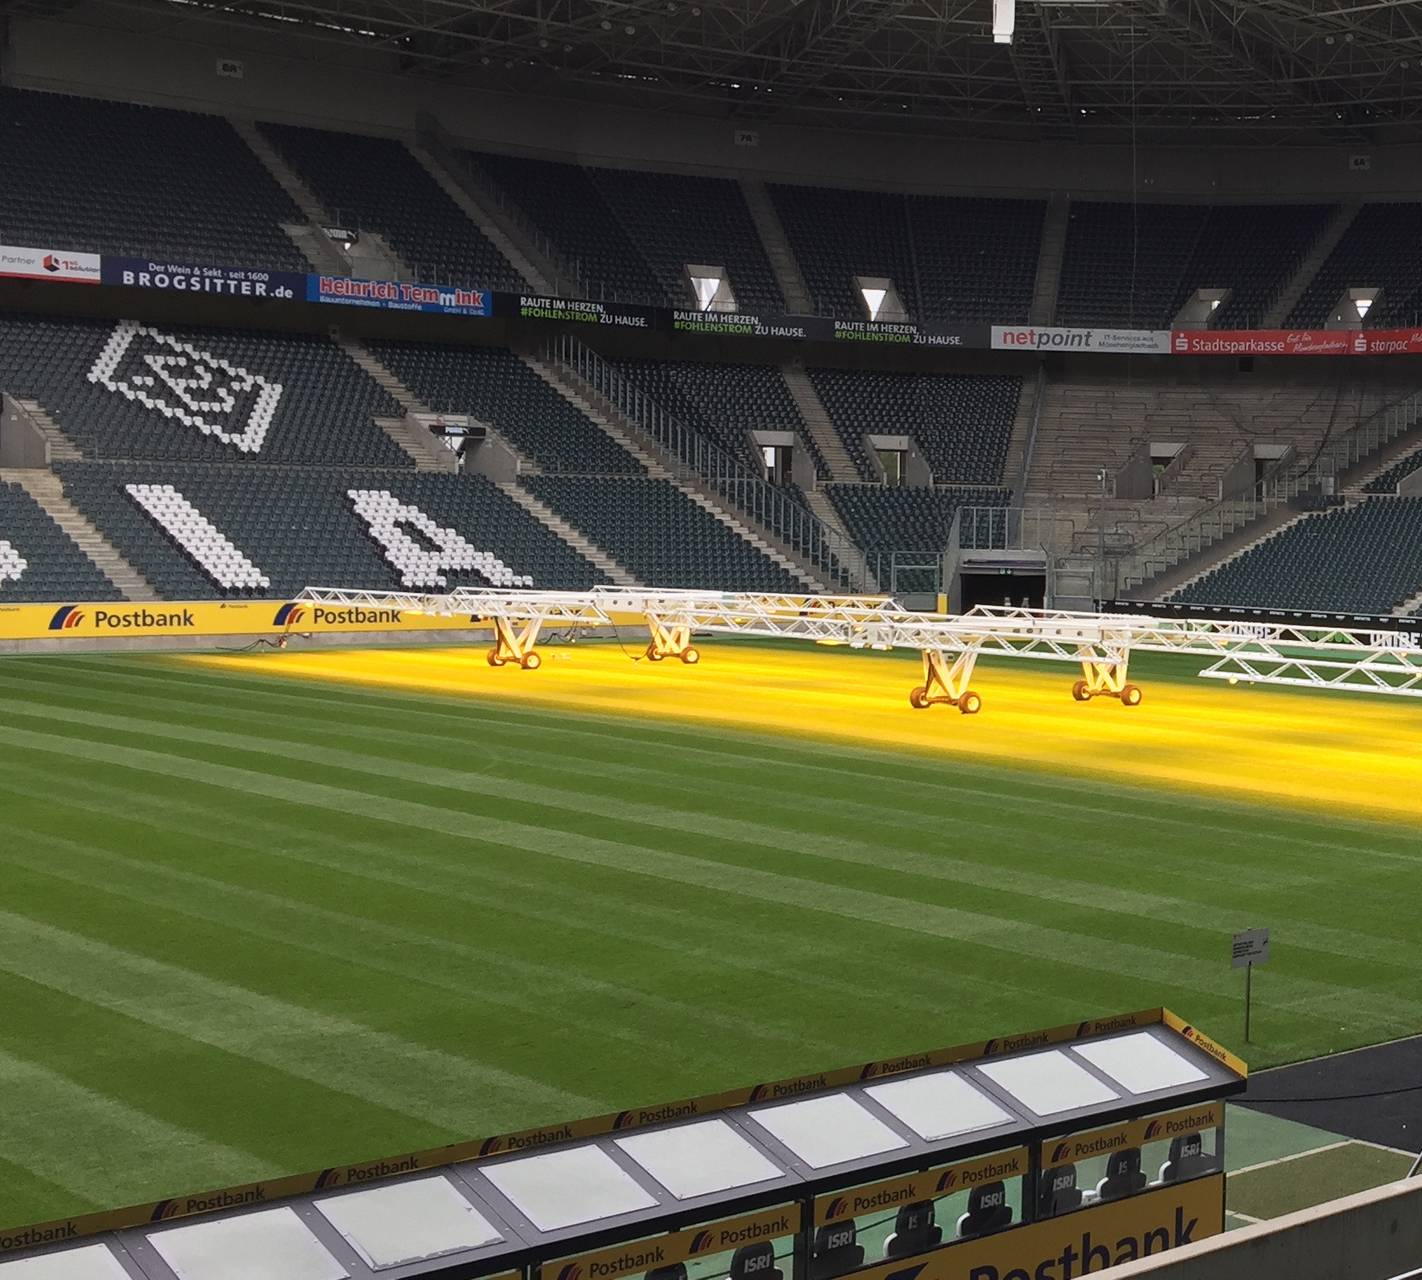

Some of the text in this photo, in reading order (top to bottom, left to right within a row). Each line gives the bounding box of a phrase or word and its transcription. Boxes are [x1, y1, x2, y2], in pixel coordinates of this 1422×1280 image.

[149, 262, 166, 272] Der
[167, 264, 192, 275] Wein
[194, 266, 201, 275] &
[203, 267, 222, 277] Sekt
[229, 270, 246, 279] seit
[247, 271, 269, 281] 1600
[123, 271, 293, 298] BROGSITTER.de
[319, 276, 399, 299] Heinrich
[520, 297, 606, 314] RAUTE IM HERZEN,
[520, 307, 648, 327] #FOHLENSTROM ZU HAUSE.
[673, 311, 761, 326] RAUTE IM HERZEN,
[674, 321, 806, 337] #FOHLENSTROM ZU HAUSE.
[835, 321, 919, 336] RAUTE IM HERZEN,
[835, 330, 962, 345] #FOHLENSTROM ZU HAUSE.
[1003, 328, 1095, 349] netpoint
[1192, 337, 1285, 353] Stadtsparkasse
[95, 608, 195, 628] Postbank
[313, 607, 402, 624] Postbank
[1094, 1014, 1137, 1033] Postbank
[1003, 1032, 1049, 1050] Postbank
[1194, 1033, 1228, 1062] Postbank
[882, 1055, 932, 1074] Postbank
[773, 1074, 827, 1098] Postbank
[639, 1101, 698, 1125] Postbank
[1165, 1110, 1215, 1134] Postbank
[508, 1125, 573, 1150] Postbank
[1074, 1131, 1128, 1156] Postbank
[347, 1156, 419, 1182] Postbank
[962, 1157, 1019, 1184] Postbank
[1052, 1174, 1075, 1192] ISRI
[186, 1185, 266, 1213] Postbank
[853, 1183, 916, 1212] Postbank
[0, 1221, 78, 1249] ostbank
[720, 1215, 789, 1245] Postbank
[589, 1246, 665, 1280] Postbank
[744, 1253, 772, 1273] ISRI
